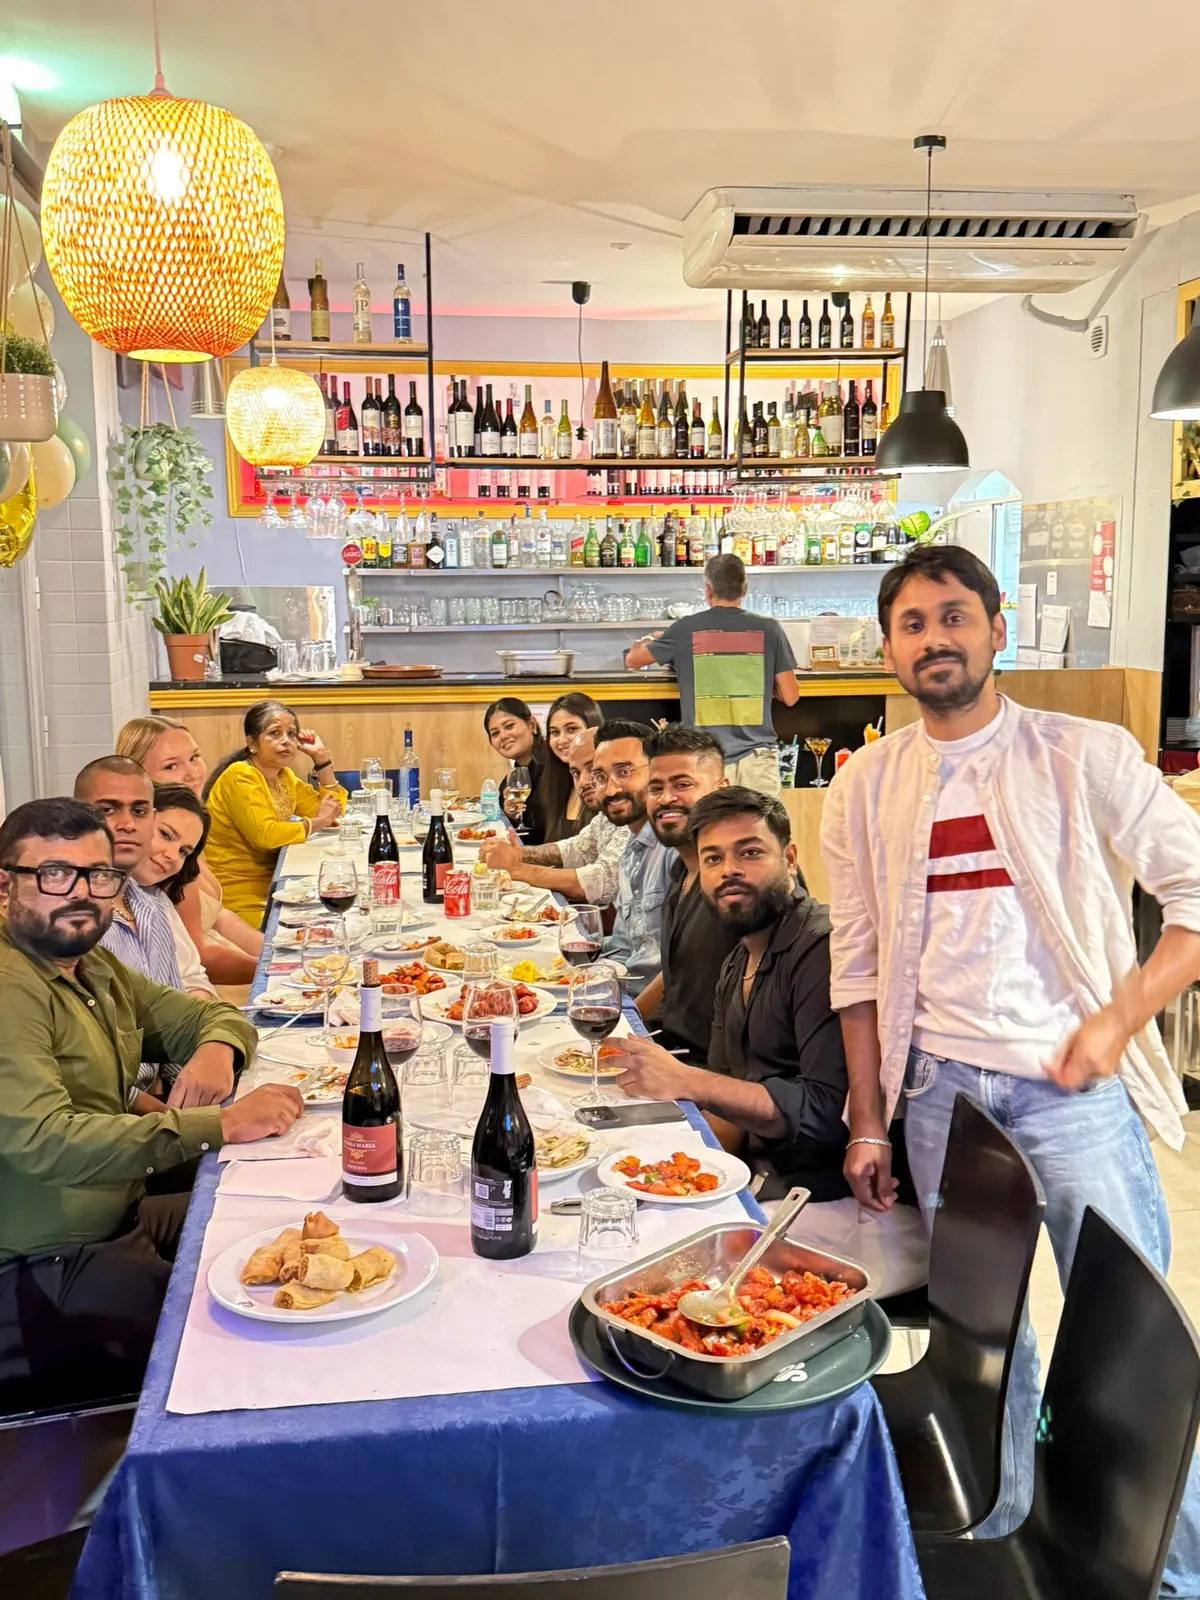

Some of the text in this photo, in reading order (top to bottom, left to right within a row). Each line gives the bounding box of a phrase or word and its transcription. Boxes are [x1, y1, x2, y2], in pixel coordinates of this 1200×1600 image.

[354, 299, 369, 316] JP
[754, 427, 768, 441] JP
[446, 876, 469, 895] Cola
